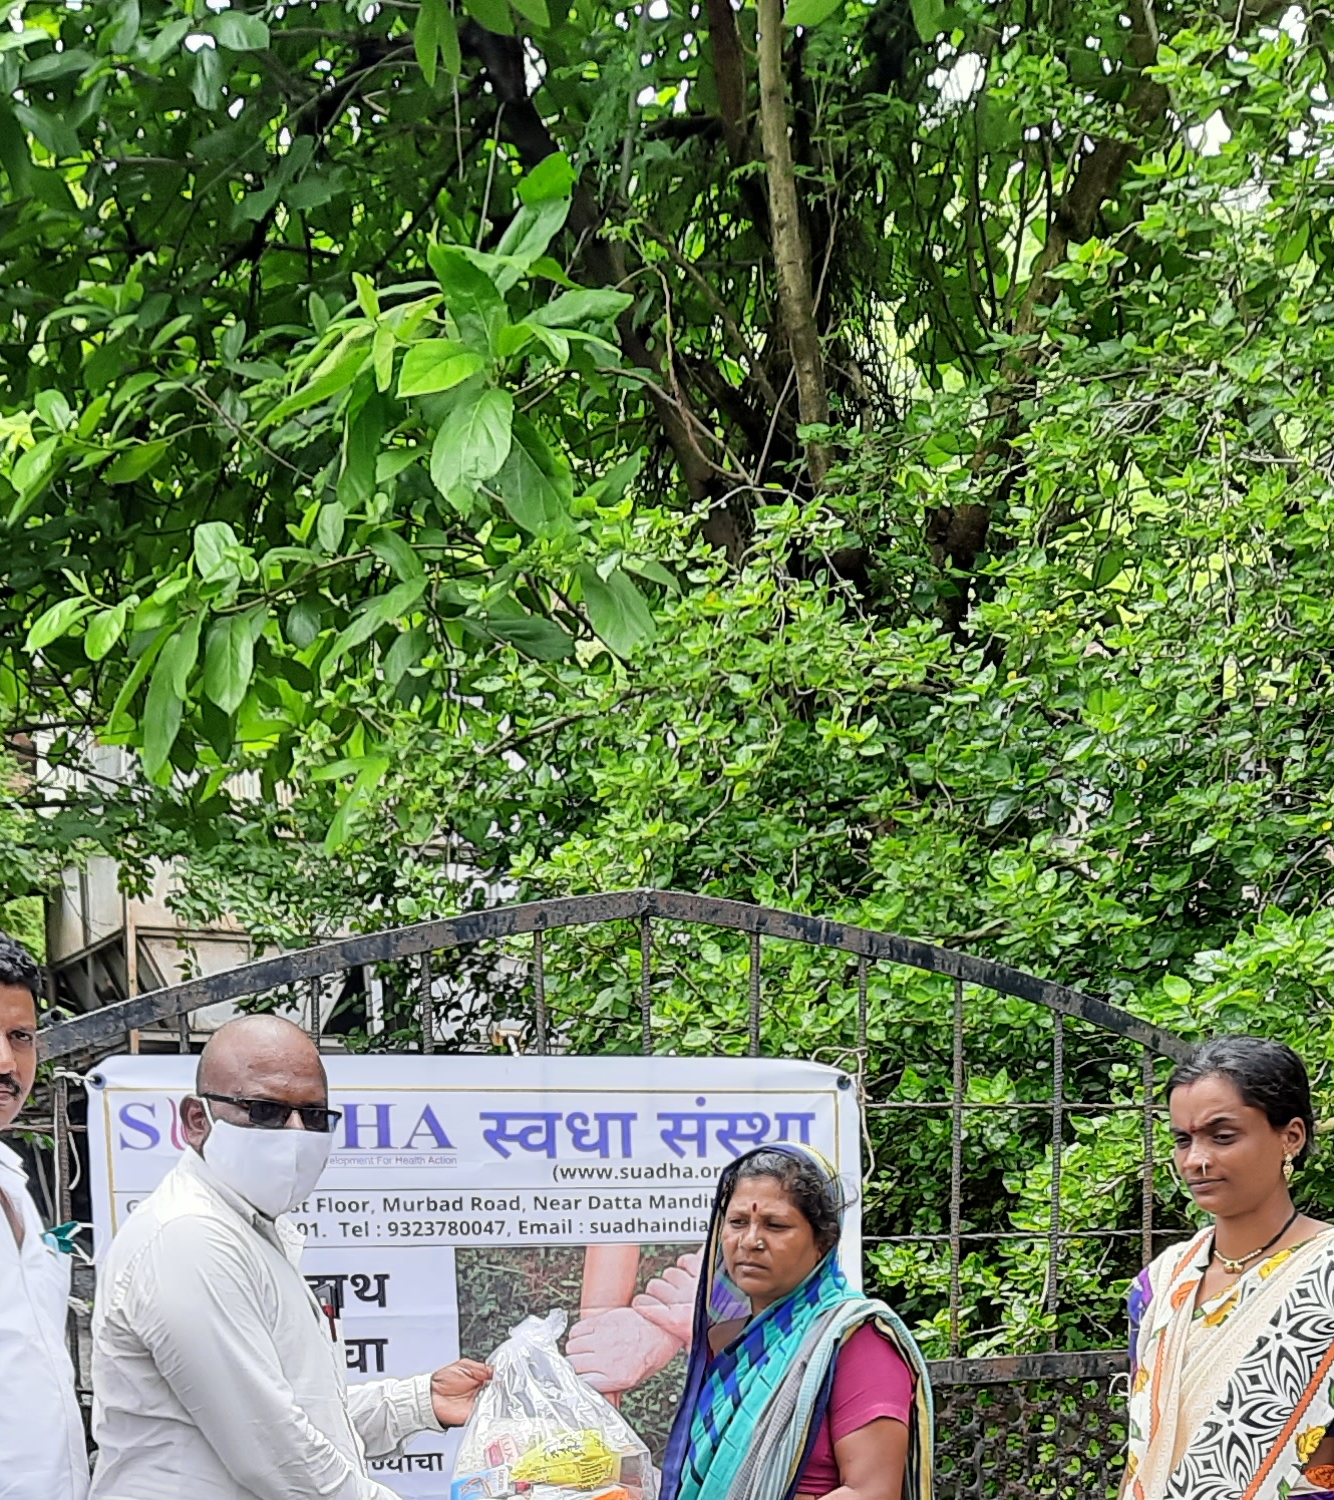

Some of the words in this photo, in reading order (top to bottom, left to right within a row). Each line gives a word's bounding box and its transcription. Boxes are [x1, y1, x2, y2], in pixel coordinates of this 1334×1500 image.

[480, 1111, 638, 1160] स्वधा
[376, 1155, 393, 1165] For
[395, 1155, 425, 1165] Health
[428, 1155, 457, 1165] Action
[552, 1163, 723, 1183] (www.suadha.or
[316, 1196, 375, 1215] Floor,
[382, 1196, 464, 1213] Murbad
[470, 1195, 526, 1213] Road,
[533, 1196, 582, 1211] Near
[588, 1195, 642, 1210] Datta
[339, 1220, 369, 1238] Tel
[387, 1219, 511, 1238] 9323780047,
[518, 1218, 572, 1235] Email
